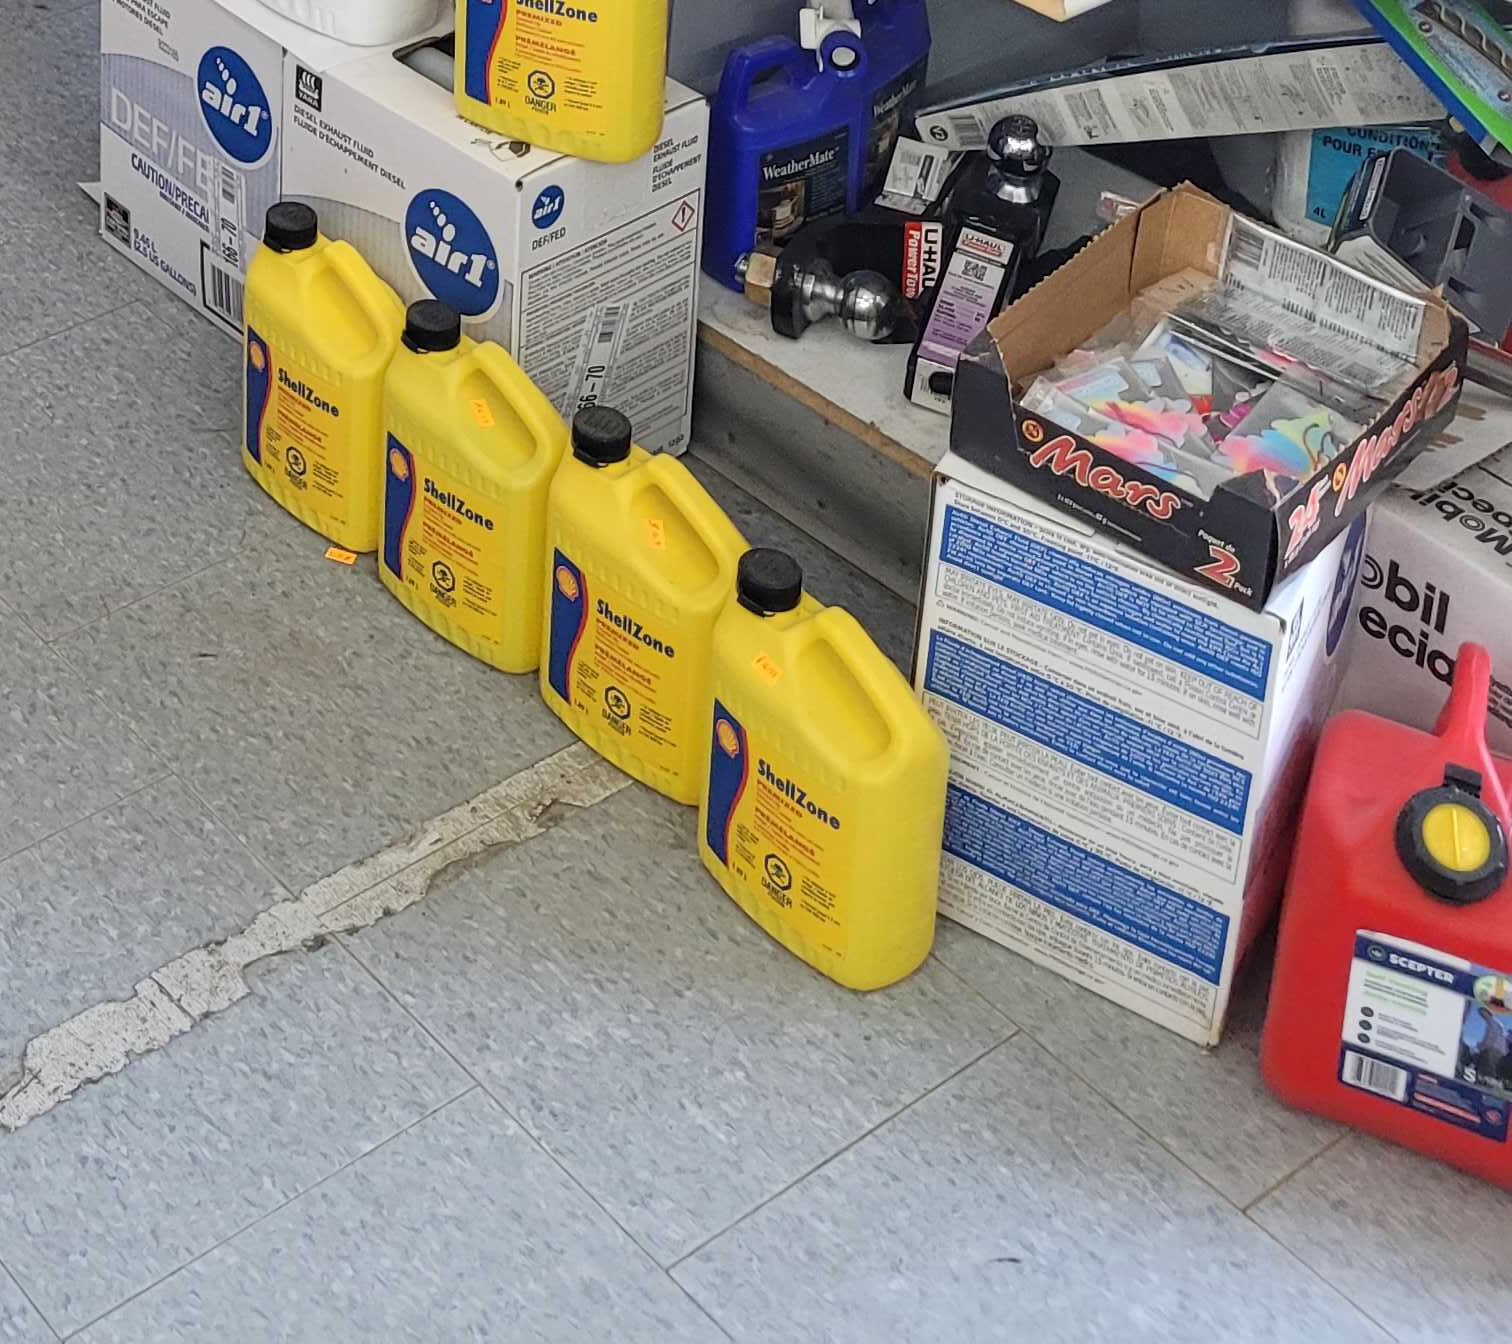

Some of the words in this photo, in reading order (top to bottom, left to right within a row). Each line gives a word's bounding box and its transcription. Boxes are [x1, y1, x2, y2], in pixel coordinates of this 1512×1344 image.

[515, 9, 563, 27] PREMIXED
[202, 81, 268, 137] air1
[297, 89, 320, 108] YARA
[524, 95, 557, 112] DANGER
[294, 104, 318, 126] DIESEL
[318, 117, 353, 147] EXHAUST
[353, 138, 374, 159] FLUID
[1323, 135, 1362, 157] POUR
[293, 116, 318, 137] FLUIDE
[383, 168, 407, 190] DIESEL
[762, 150, 835, 181] WeatherMate
[533, 195, 563, 220] air1
[1313, 207, 1326, 218] 4L
[410, 225, 488, 288] air1
[531, 226, 567, 251] DEF/FED
[278, 367, 339, 417] ShellZone
[1029, 435, 1181, 520] Mars
[423, 478, 494, 531] ShellZone
[1194, 545, 1240, 588] 2
[1233, 583, 1253, 597] Pack
[596, 598, 676, 658] ShellZone
[758, 759, 841, 831] ShellZone
[761, 876, 793, 910] DANGER
[1389, 953, 1454, 984] SCEPTER
